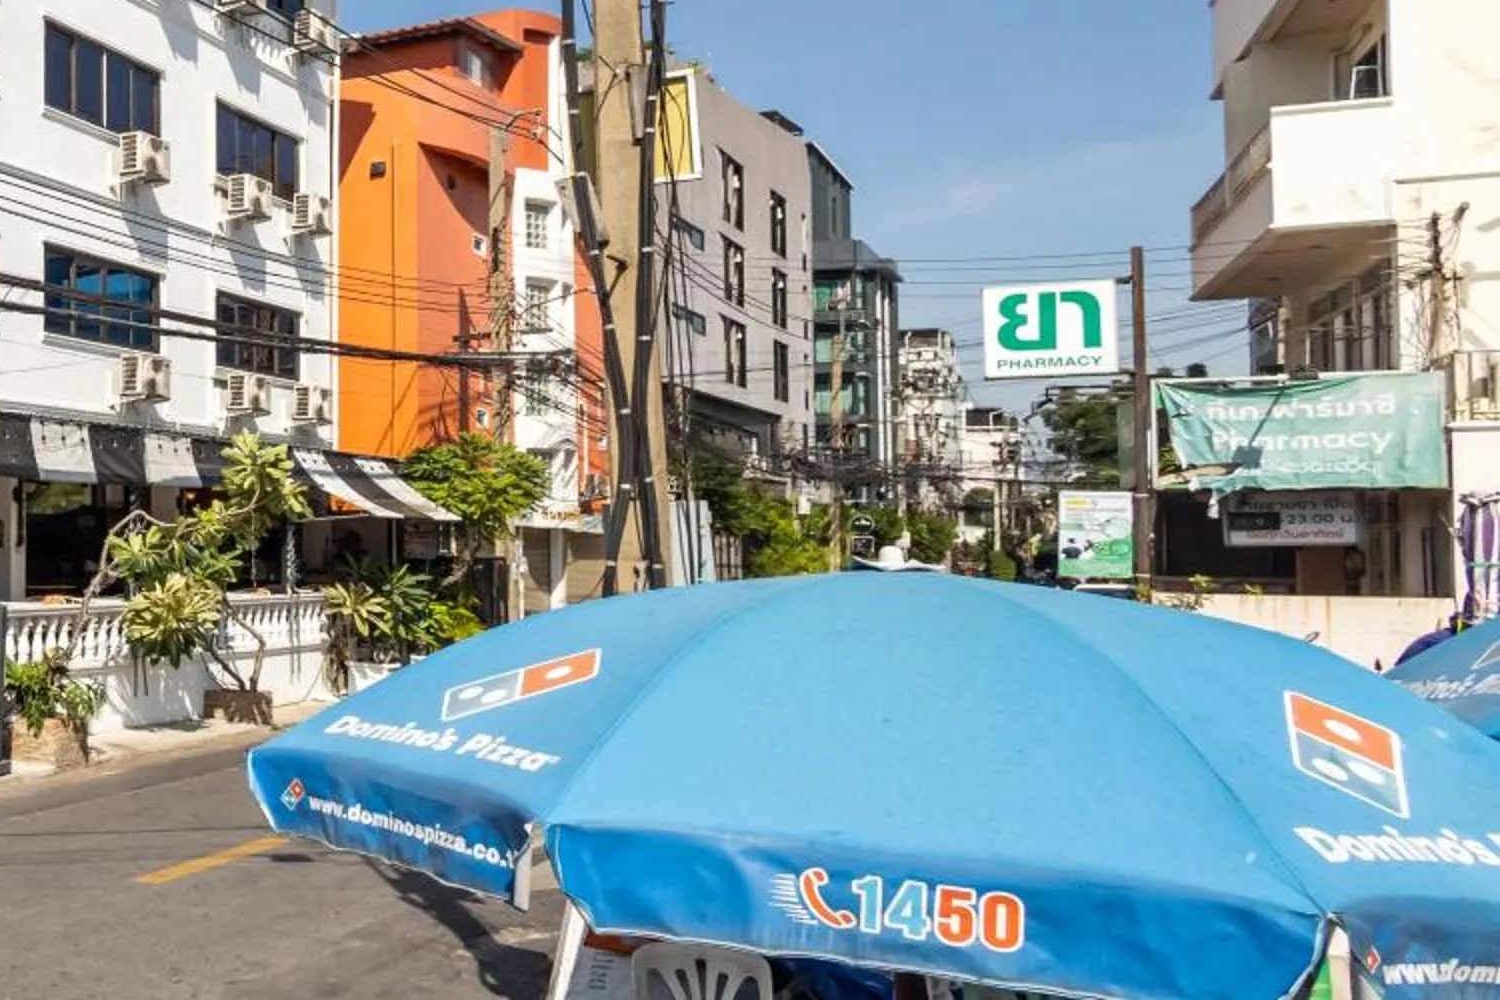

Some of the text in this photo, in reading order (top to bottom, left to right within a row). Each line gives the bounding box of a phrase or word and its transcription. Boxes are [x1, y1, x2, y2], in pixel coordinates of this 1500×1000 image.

[997, 290, 1103, 352] ยา
[996, 355, 1104, 370] PHARMACY
[1213, 430, 1396, 455] Pharmacy
[324, 714, 551, 772] Domino's Pizza
[308, 795, 519, 869] www.dominospizza.co.t
[1292, 824, 1498, 866] Domino's
[851, 874, 1026, 953] 1450
